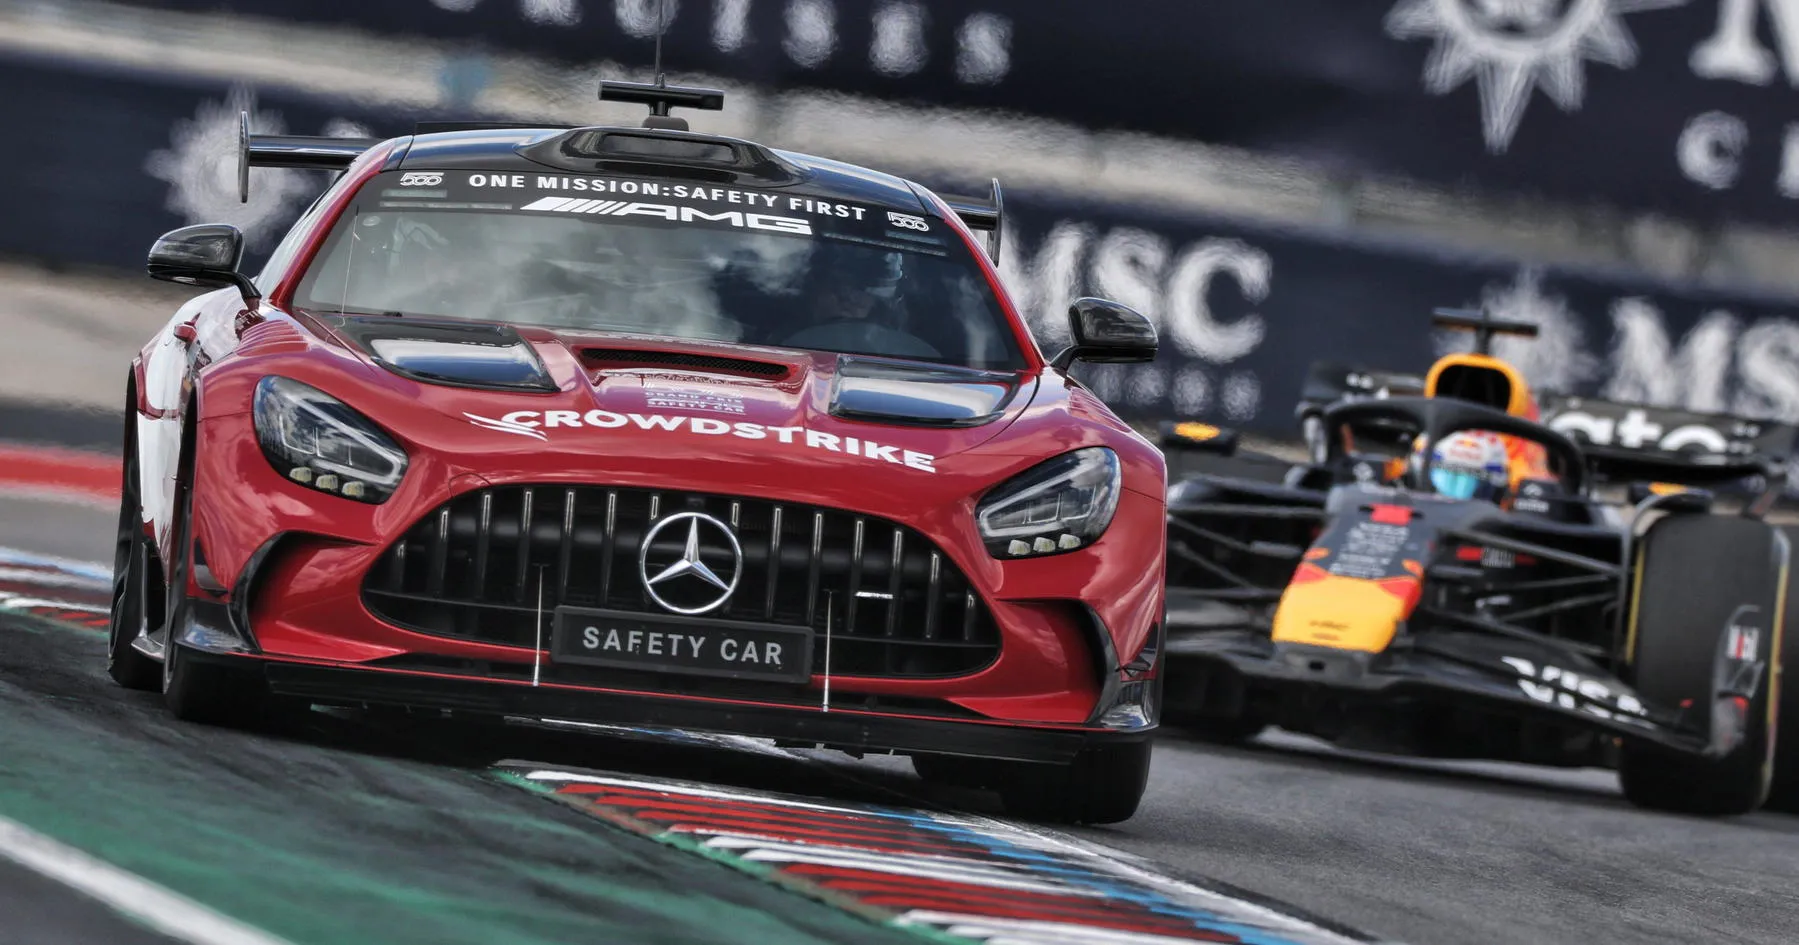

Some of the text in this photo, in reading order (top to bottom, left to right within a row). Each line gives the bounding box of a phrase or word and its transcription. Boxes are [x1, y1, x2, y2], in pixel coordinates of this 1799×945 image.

[400, 172, 444, 187] 500
[469, 174, 525, 188] ONE
[789, 197, 867, 221] FIRST
[606, 201, 813, 235] AMG
[887, 211, 930, 232] 500
[647, 400, 745, 413] SAFETY CAR
[501, 409, 937, 474] CROWDSTRIKE
[582, 626, 784, 665] SAFETY CAR
